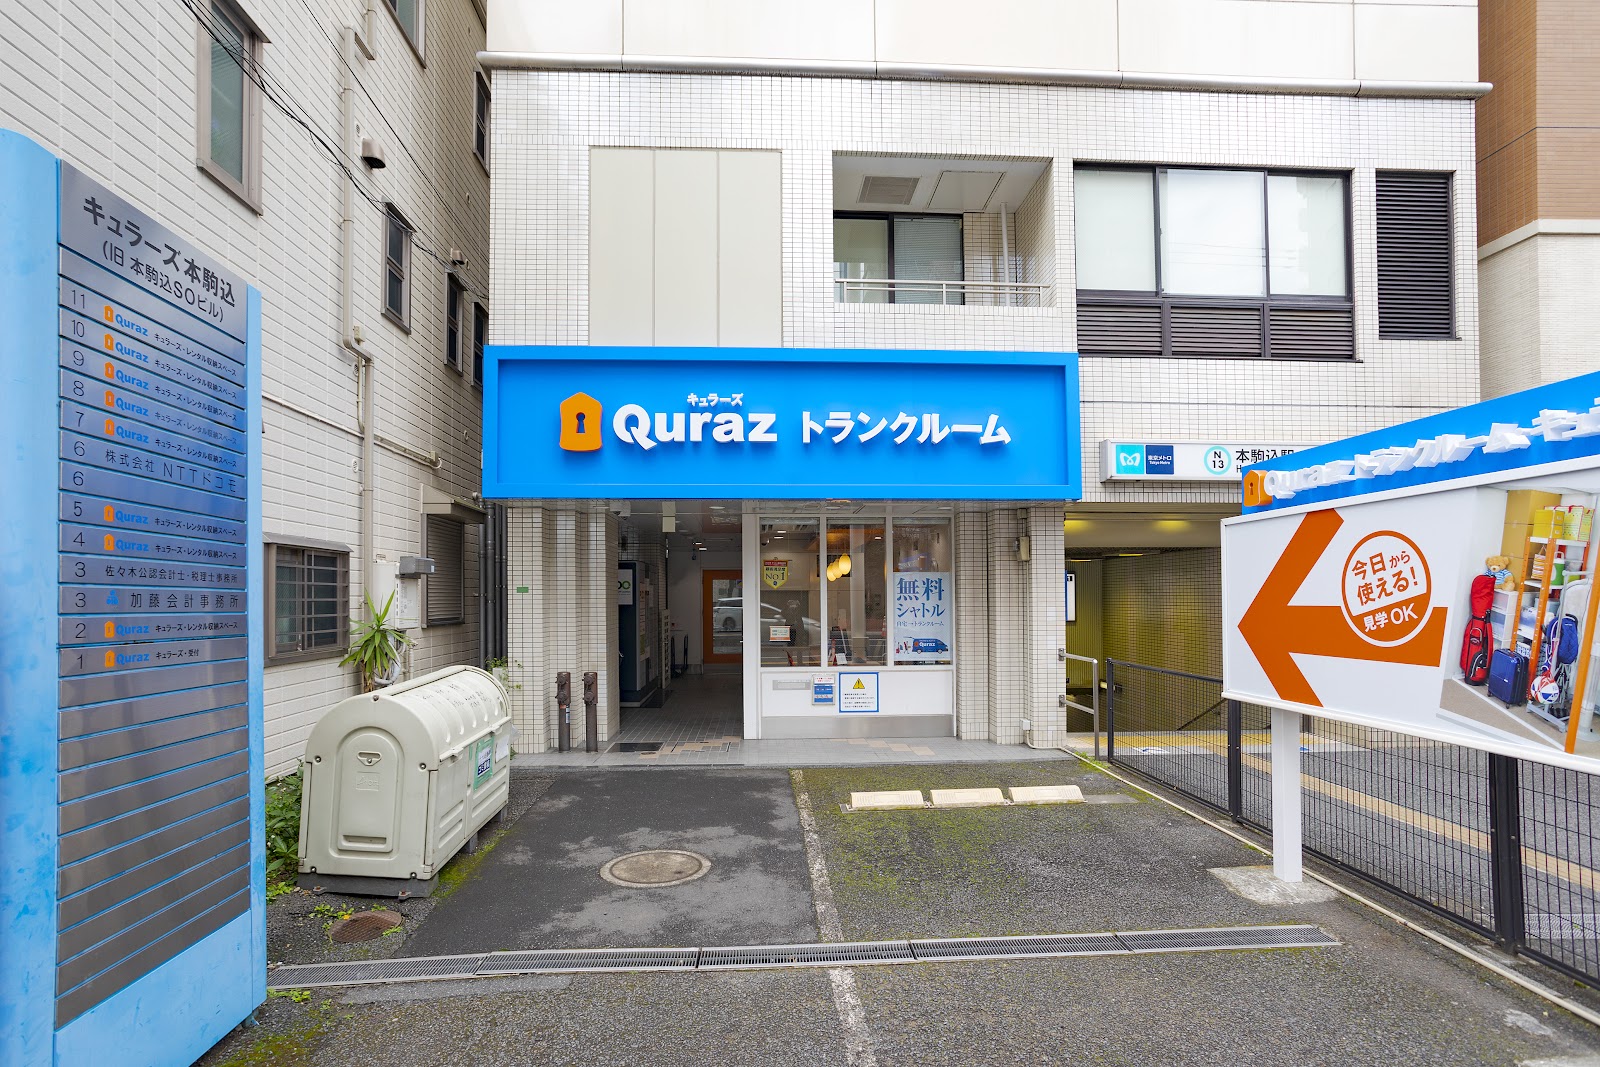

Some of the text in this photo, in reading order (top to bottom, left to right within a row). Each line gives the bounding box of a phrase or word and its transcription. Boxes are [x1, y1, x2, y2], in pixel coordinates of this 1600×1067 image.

[71, 289, 86, 310] 11
[115, 313, 149, 337] Quraz
[71, 319, 85, 338] 10
[115, 341, 149, 364] Quraz
[73, 350, 85, 367] 9
[115, 369, 149, 391] Quraz
[73, 380, 85, 398] 8
[115, 396, 149, 417] Quraz
[686, 392, 744, 408] キュラーズ
[75, 411, 85, 427] 7
[116, 425, 150, 444] Quraz
[612, 403, 1012, 451] Quraz トランクルーム
[73, 440, 86, 457] 6
[104, 449, 155, 474] 株式会社
[1212, 460, 1225, 469] 13
[1213, 450, 1222, 459] N
[72, 471, 85, 487] 6
[73, 501, 83, 517] 5
[115, 509, 149, 525] Quraz
[73, 531, 85, 547] 4
[115, 539, 149, 552] Quraz
[74, 561, 86, 578] 3
[896, 577, 945, 602] 無料
[74, 592, 239, 609] 3 加藤会計事務所
[896, 602, 946, 618] シャトル
[75, 622, 87, 639] 2
[116, 623, 150, 636] Quraz
[76, 648, 200, 669] 1 Quraz キュラーズ・受付
